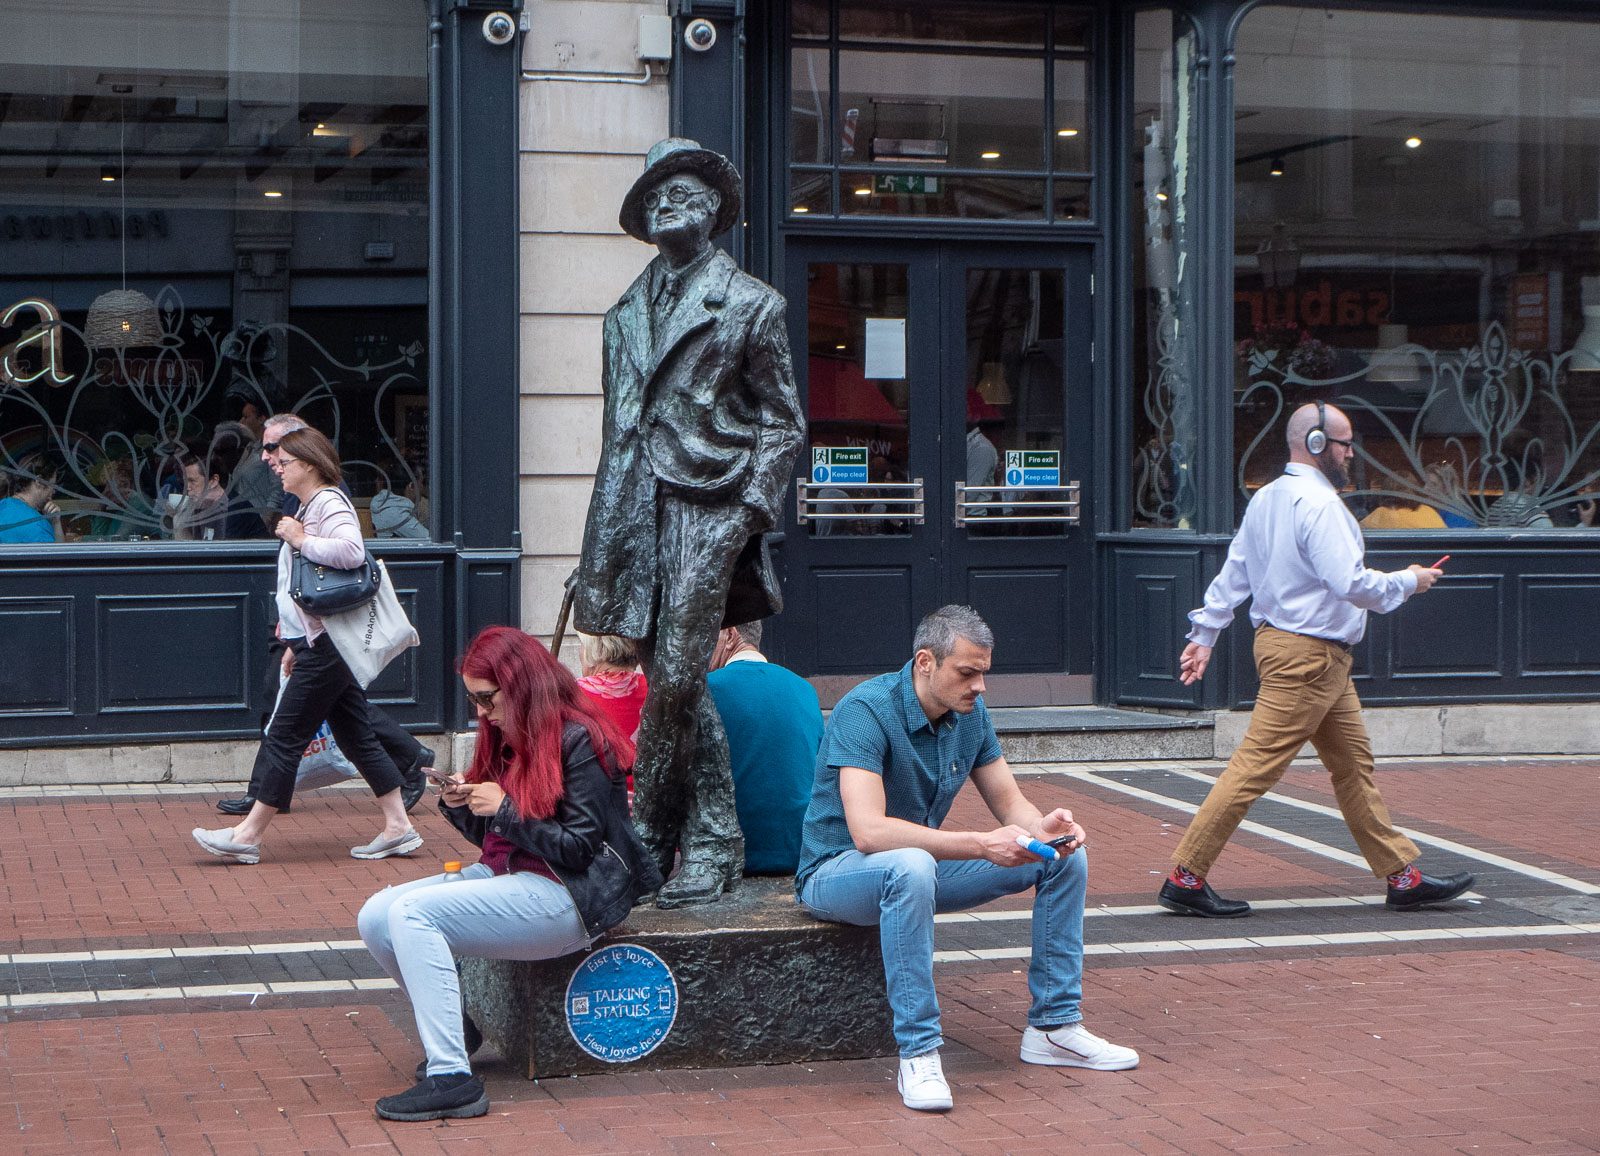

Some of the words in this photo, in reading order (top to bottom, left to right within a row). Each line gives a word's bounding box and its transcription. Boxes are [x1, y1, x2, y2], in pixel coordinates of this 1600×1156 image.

[835, 452, 848, 460] Fire
[849, 452, 862, 460] exit
[624, 949, 654, 969] Joyce
[593, 986, 651, 1003] TALKING
[593, 1003, 651, 1020] STATUES
[583, 1033, 608, 1055] Hear
[608, 1046, 638, 1059] Joyce
[639, 1028, 662, 1050] here
